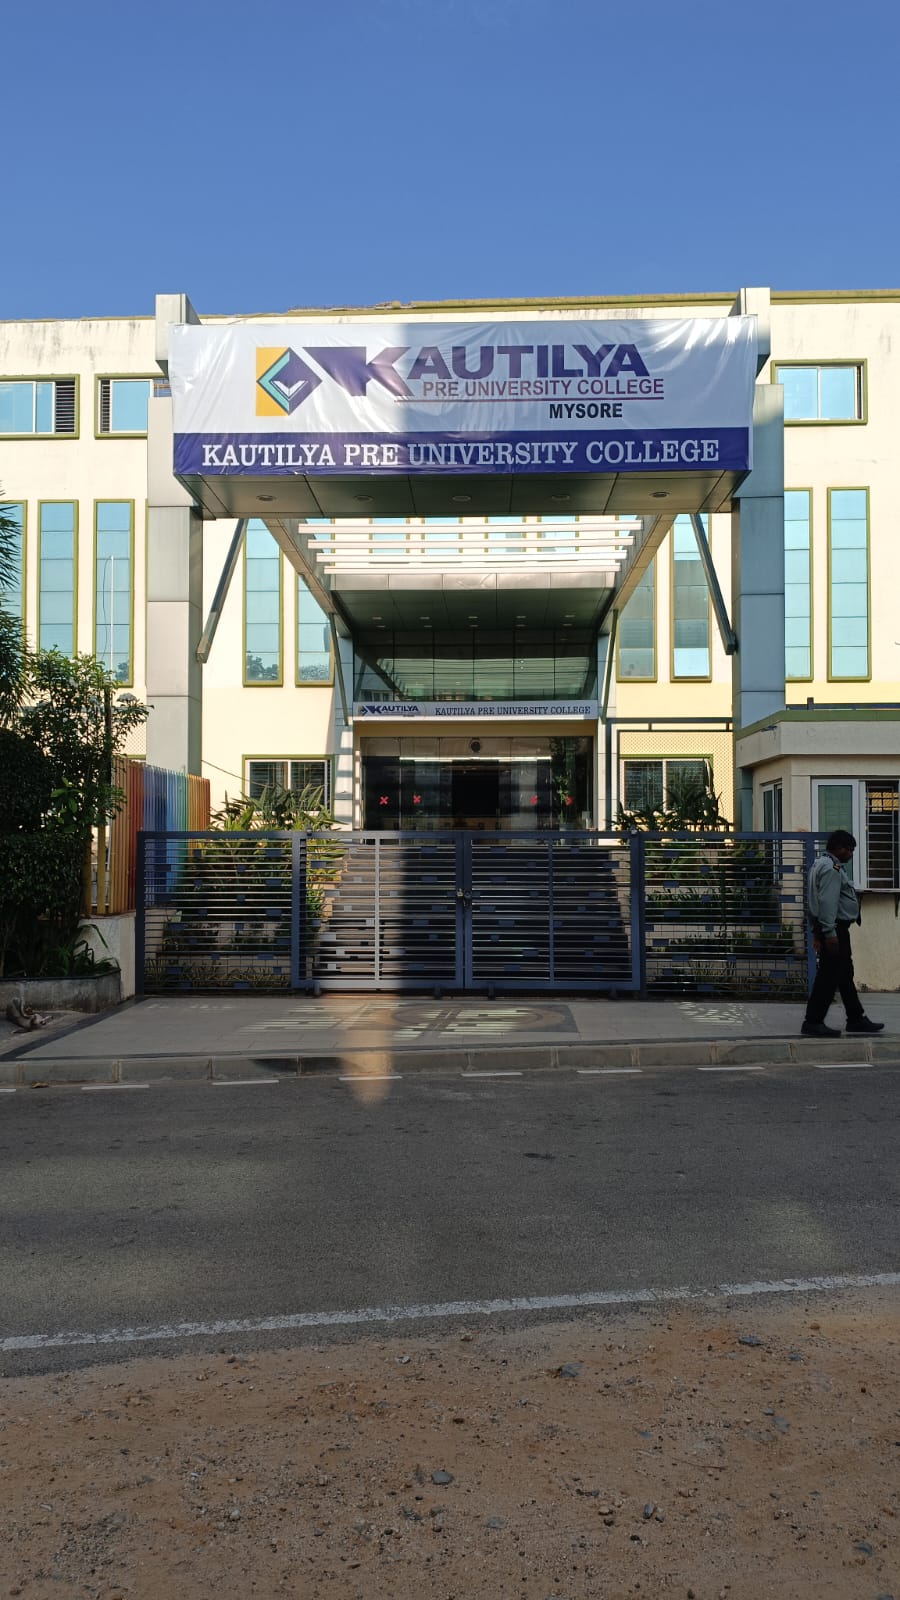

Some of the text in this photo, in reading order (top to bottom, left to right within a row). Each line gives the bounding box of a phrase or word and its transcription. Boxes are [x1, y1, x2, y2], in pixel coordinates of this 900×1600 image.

[303, 343, 651, 397] KAUTILYA
[422, 377, 665, 397] PRE UNIVERSITY COLLEGE
[549, 402, 623, 419] MYSORE
[201, 439, 720, 467] KAUTILYA PRE UNIVERSITY COLLEGE
[365, 705, 419, 714] KAUTILYA
[435, 705, 591, 716] KAUTILYA PRE UNIVERSITY COLLEGE
